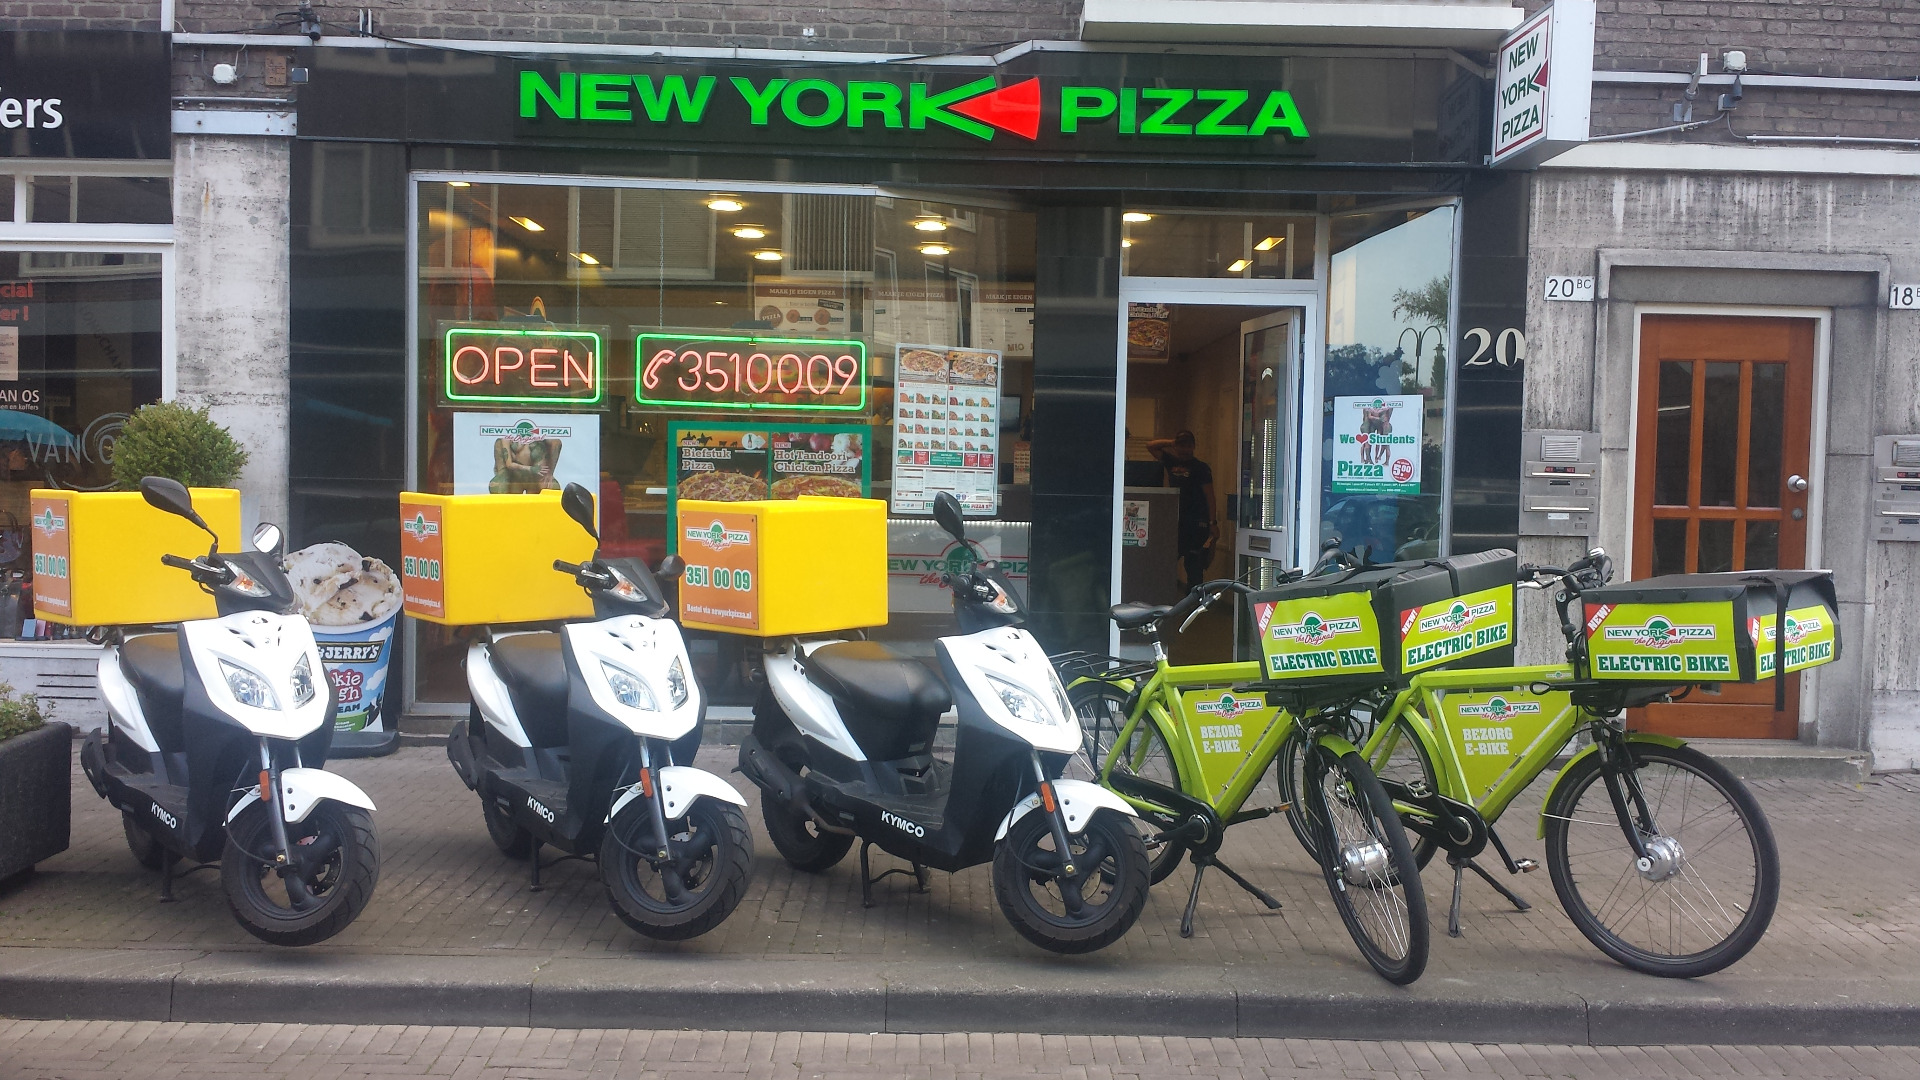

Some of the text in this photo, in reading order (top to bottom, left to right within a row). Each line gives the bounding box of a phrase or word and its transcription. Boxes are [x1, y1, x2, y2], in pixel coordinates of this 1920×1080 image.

[1509, 33, 1539, 72] NEW
[1502, 62, 1542, 109] YORK
[520, 71, 1310, 142] NEW YORK PIZZA
[1502, 104, 1539, 143] PIZZA
[1462, 327, 1526, 367] 20
[452, 345, 593, 389] OPEN
[678, 350, 858, 395] 3510009
[22, 389, 40, 403] OS
[505, 427, 532, 436] YORK
[1339, 433, 1415, 444] We Students
[26, 432, 80, 464] VAN
[682, 448, 732, 459] Biefstuk
[774, 450, 848, 461] Hot Tandoori
[682, 460, 715, 470] Pizza
[774, 461, 856, 474] Chicken Pizza
[1337, 461, 1384, 477] Pizza
[687, 530, 748, 542] NEW YORK PIZZA
[35, 553, 46, 575] 351
[404, 556, 440, 580] 351 00 09
[686, 565, 751, 590] 351 00 09
[703, 606, 711, 614] via
[1259, 603, 1274, 631] NEW!
[1421, 604, 1495, 629] NEW YORK PIZZA
[1587, 604, 1611, 631] NEW!
[1274, 621, 1358, 636] NEW YORK PIZZA
[1401, 609, 1418, 635] NEW!
[1802, 621, 1820, 630] PIZZA
[1295, 631, 1336, 645] the Original
[1607, 628, 1713, 638] NEW YORK PIZZA
[1645, 635, 1685, 647] Original
[325, 644, 380, 660] JERRY'S
[1407, 624, 1507, 666] ELECTRIC BIKE
[1271, 648, 1378, 671] ELECTRIC BIKE
[1598, 655, 1730, 671] ELECTRIC BIKE
[1760, 641, 1831, 672] ELETRIC BIKE
[331, 671, 361, 687] kie
[1197, 703, 1213, 711] NEW
[1215, 702, 1234, 711] YORK
[1481, 705, 1505, 714] YORK
[1512, 704, 1539, 712] PIZZA
[1200, 724, 1243, 739] BEZORG
[1462, 727, 1513, 741] BEZORG
[1202, 739, 1241, 754] E-BIKE
[1464, 742, 1510, 755] E-BIKE
[150, 801, 177, 829] KYMCO
[527, 795, 555, 823] KYMCO
[881, 810, 925, 838] KYMCO
